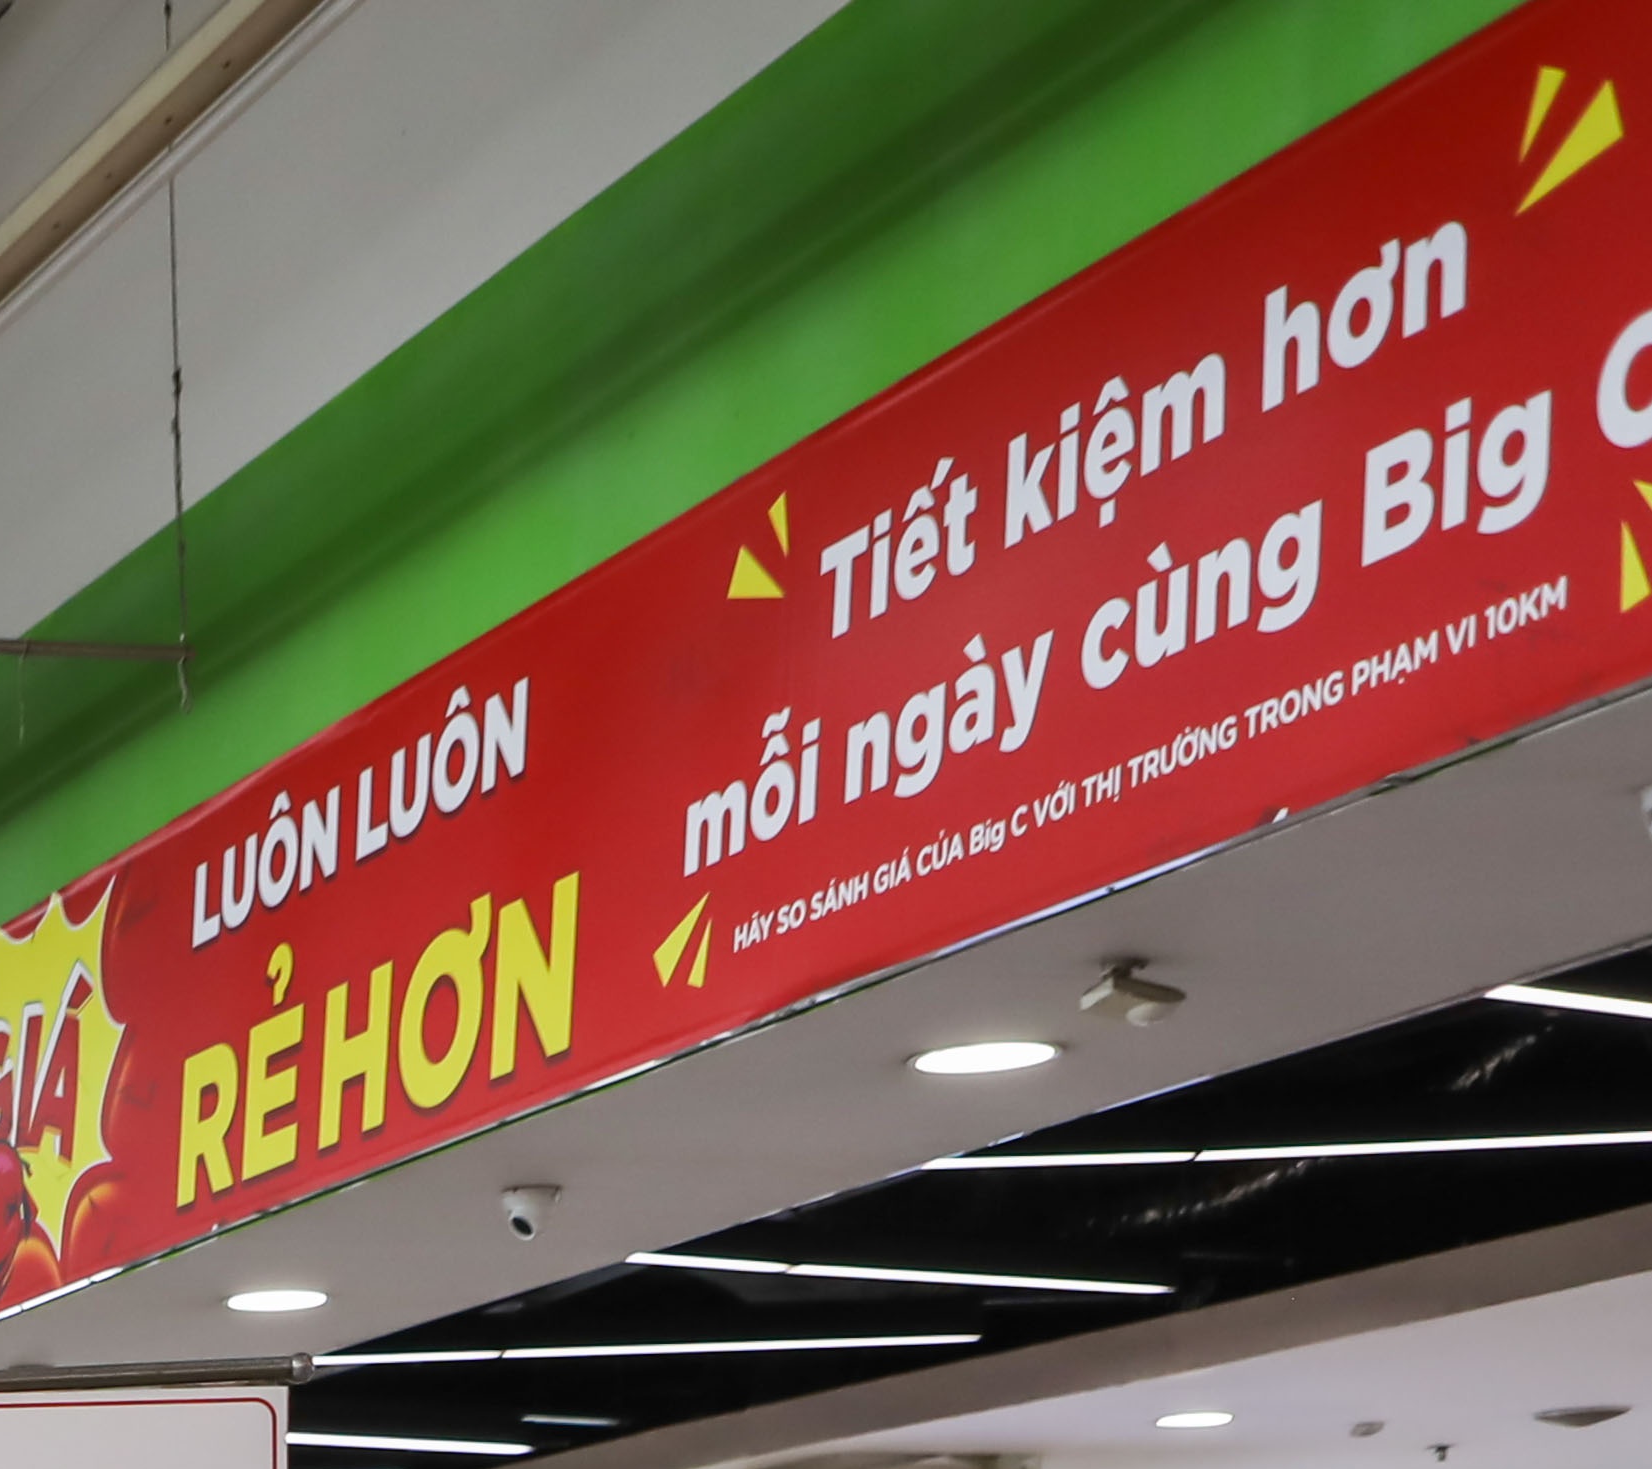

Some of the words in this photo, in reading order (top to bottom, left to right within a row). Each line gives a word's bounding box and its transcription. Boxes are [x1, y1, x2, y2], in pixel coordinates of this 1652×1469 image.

[819, 458, 978, 638] Tiết
[1003, 372, 1227, 549] kiệm
[1261, 220, 1468, 412] hơn
[192, 790, 340, 948] LUÔN
[355, 676, 530, 862] LUÔN
[682, 708, 819, 876] mỗi
[843, 631, 1052, 801] ngày
[1080, 543, 1323, 690] cùng
[1361, 396, 1552, 567] Big
[733, 908, 776, 952] HÃY
[777, 895, 806, 935] SO
[809, 868, 870, 927] SÁNH
[873, 845, 912, 897] GIÁ
[915, 824, 964, 888] CỦA
[968, 818, 1006, 864] Big
[1010, 800, 1030, 843] C
[1127, 716, 1238, 790] TRƯỜNG
[1244, 672, 1345, 741] TRONG
[1350, 630, 1439, 704] PHẠM
[1444, 615, 1475, 657] VI
[1485, 575, 1569, 640] 10KM
[176, 942, 304, 1208] RẺ
[318, 871, 580, 1152] HƠN
